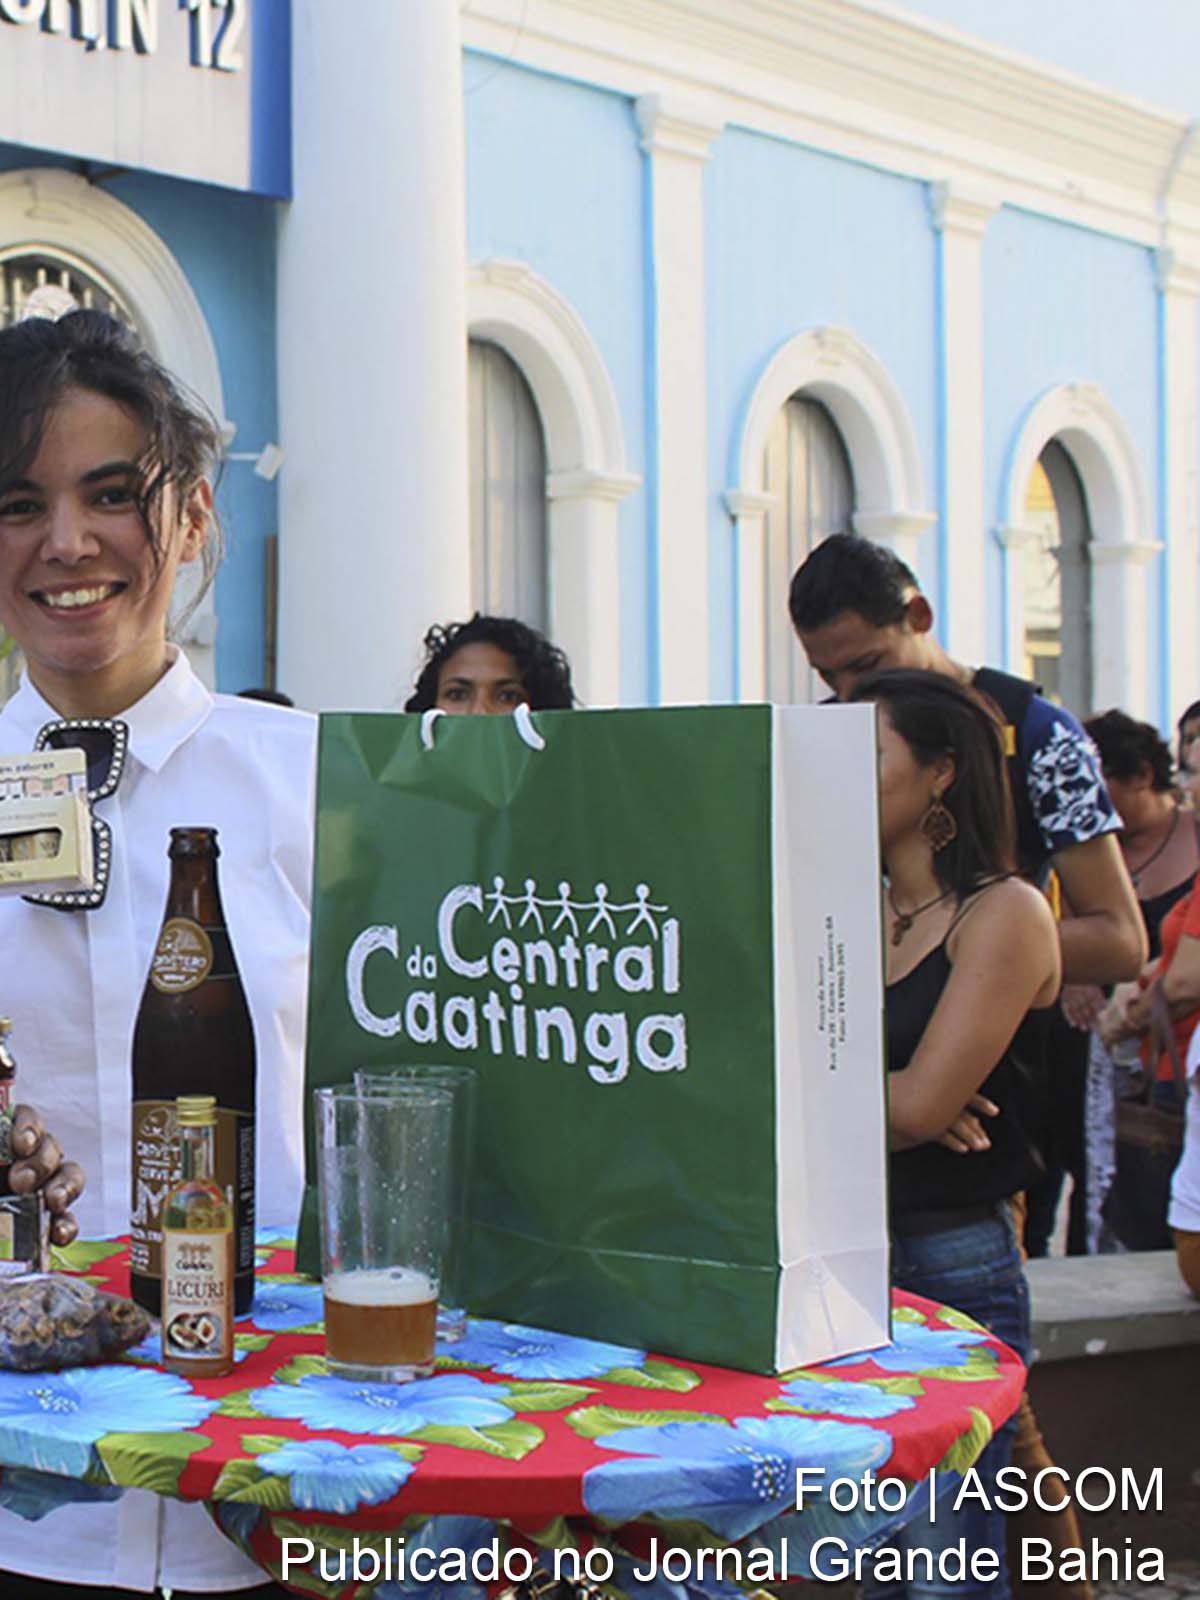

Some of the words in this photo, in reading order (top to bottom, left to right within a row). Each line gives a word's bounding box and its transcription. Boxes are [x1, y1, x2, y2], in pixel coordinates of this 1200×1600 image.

[406, 945, 437, 979] da
[438, 884, 679, 993] Central
[346, 924, 687, 1084] Caatinga
[167, 1280, 224, 1298] LICURI
